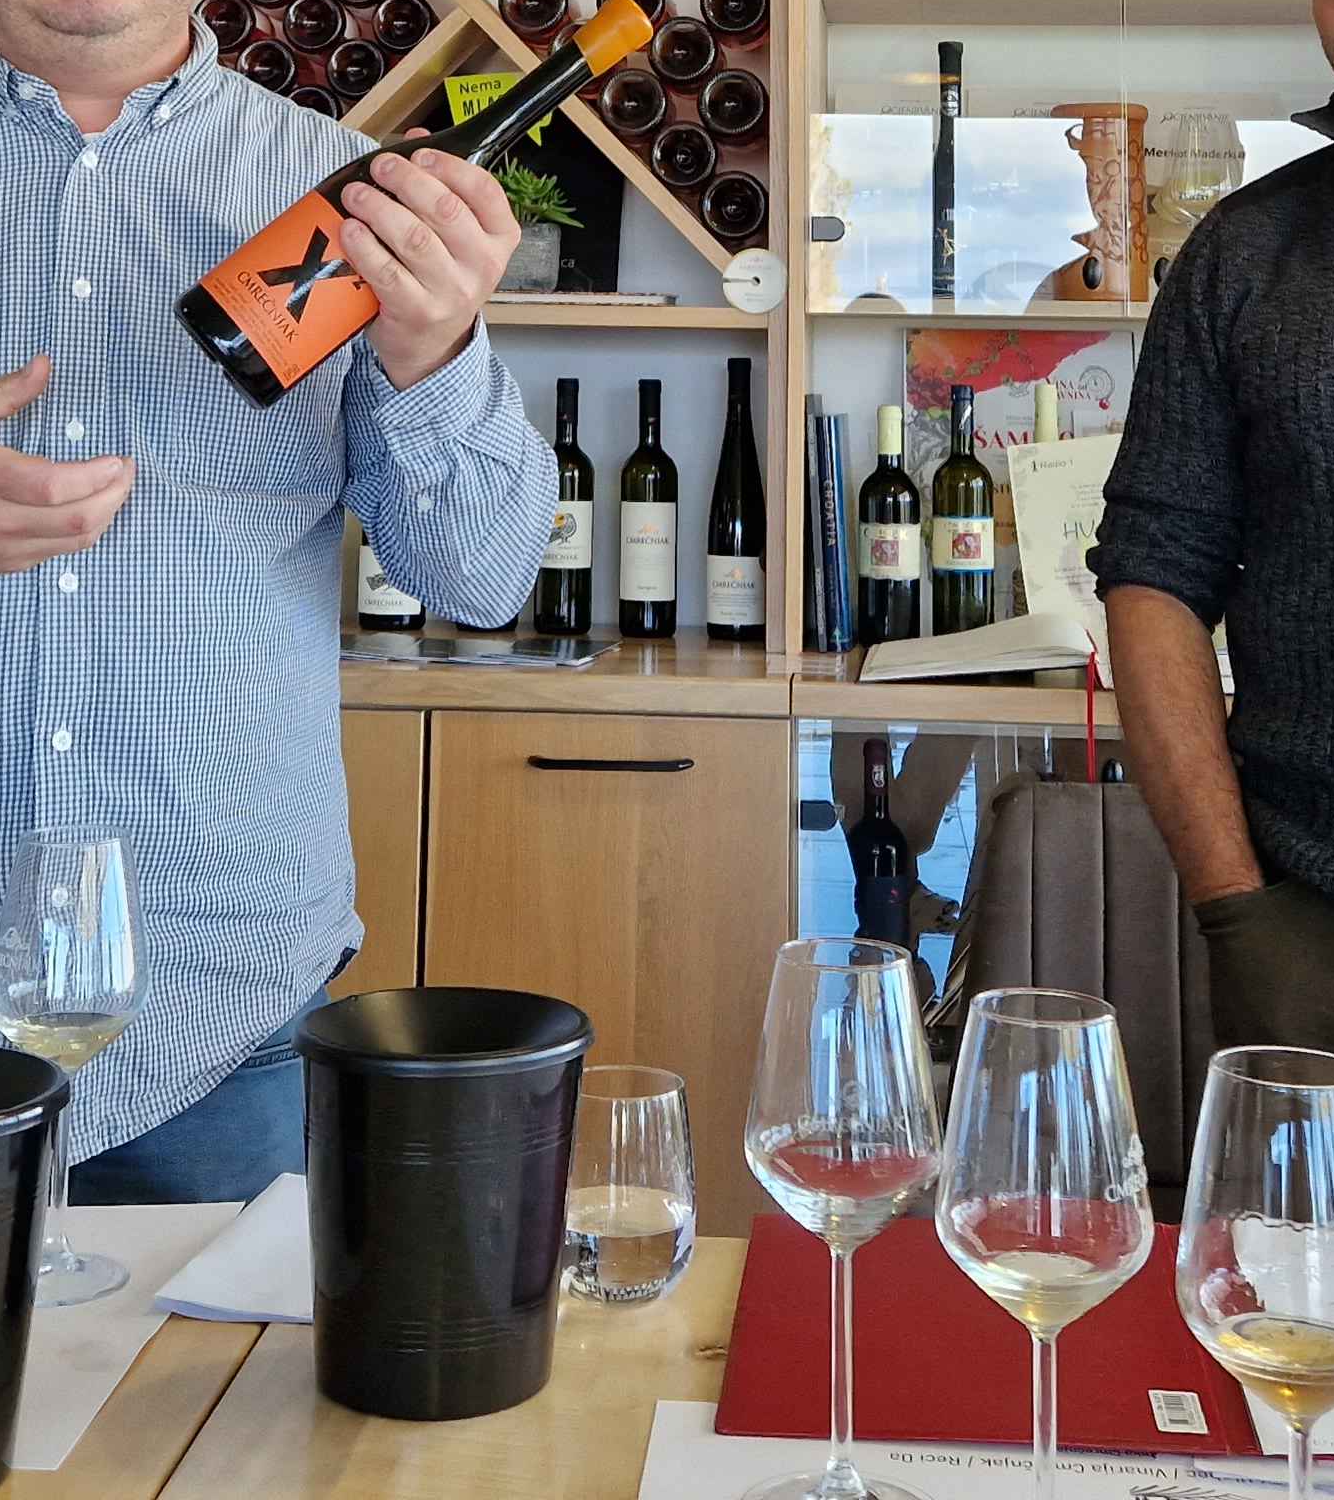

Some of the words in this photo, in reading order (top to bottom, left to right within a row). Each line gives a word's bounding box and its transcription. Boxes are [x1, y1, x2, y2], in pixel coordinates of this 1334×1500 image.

[459, 79, 502, 95] Nema
[236, 270, 300, 344] CMREČNJAK
[822, 479, 837, 548] CROATIA
[920, 1451, 962, 1467] Reci
[1091, 1461, 1168, 1481] Vinarija
